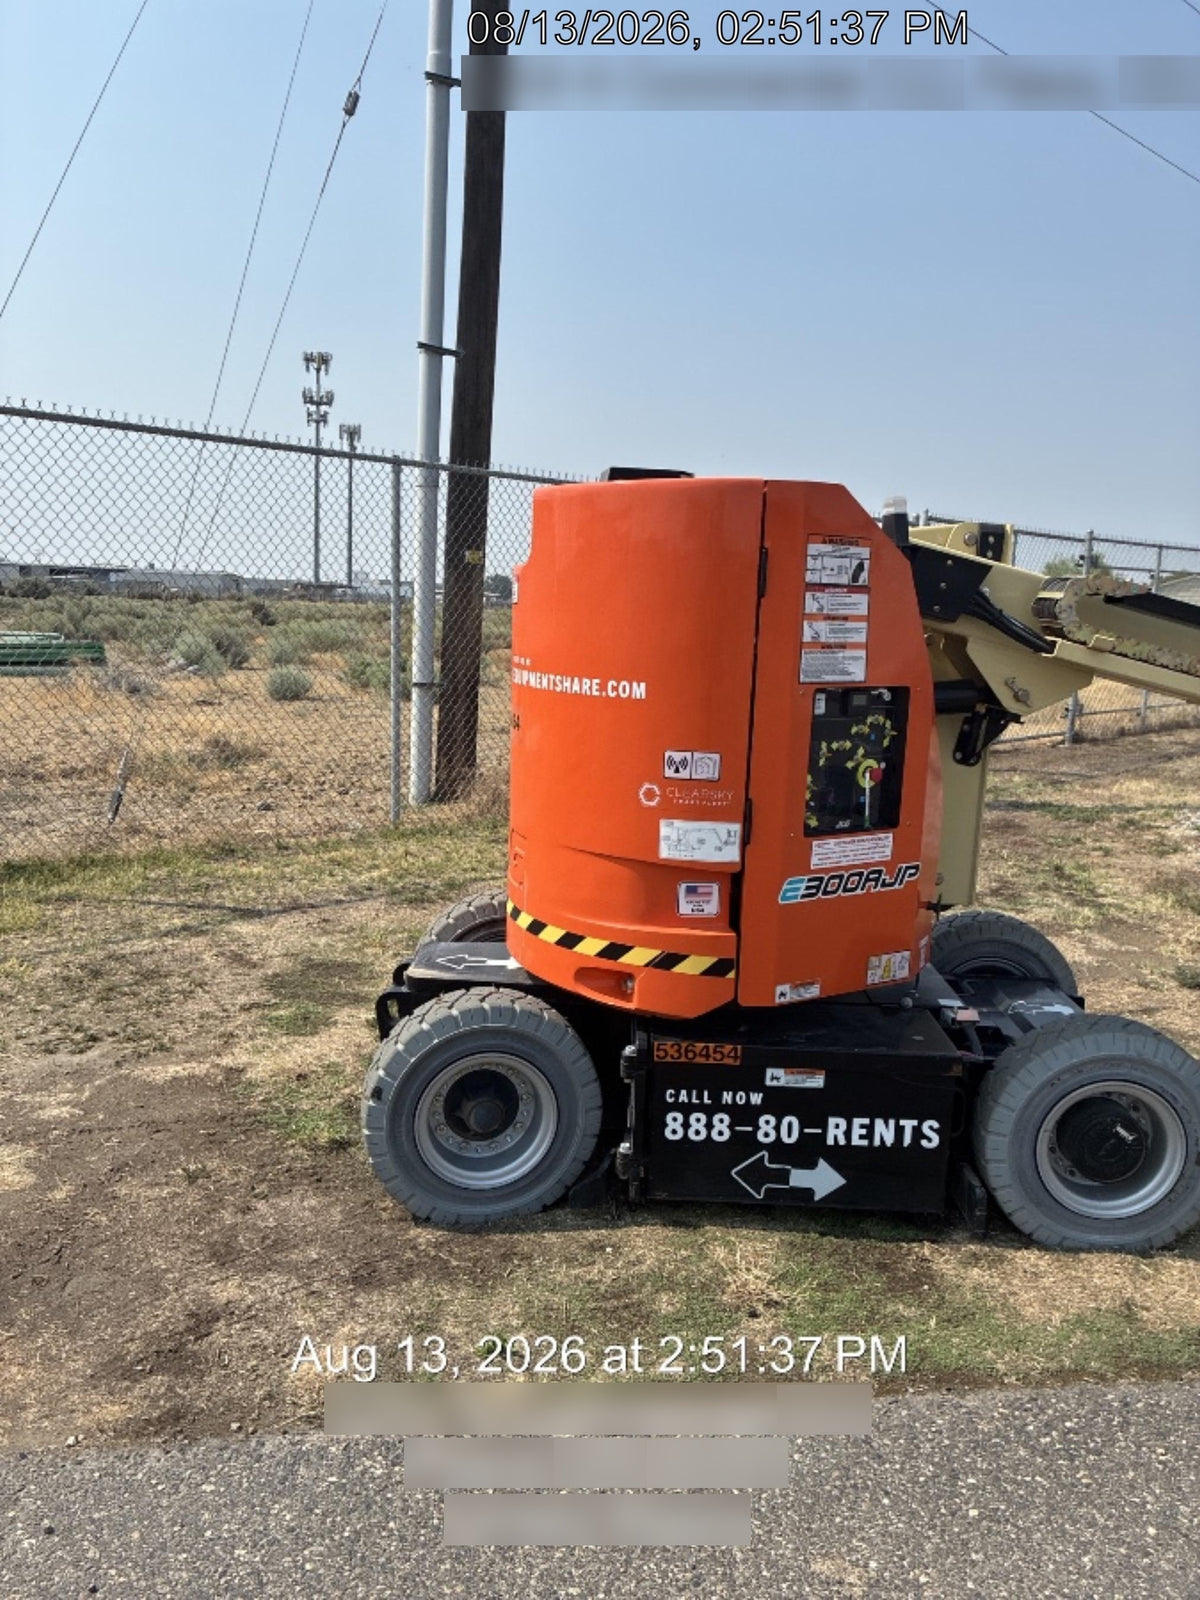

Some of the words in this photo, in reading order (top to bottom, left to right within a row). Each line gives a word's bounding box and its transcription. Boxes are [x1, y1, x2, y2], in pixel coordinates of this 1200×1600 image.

[779, 863, 920, 903] E300AJP
[655, 1043, 740, 1063] 536454
[665, 1089, 712, 1104] CALL
[722, 1091, 763, 1106] NOW
[664, 1112, 940, 1149] 888-80-RENTS
